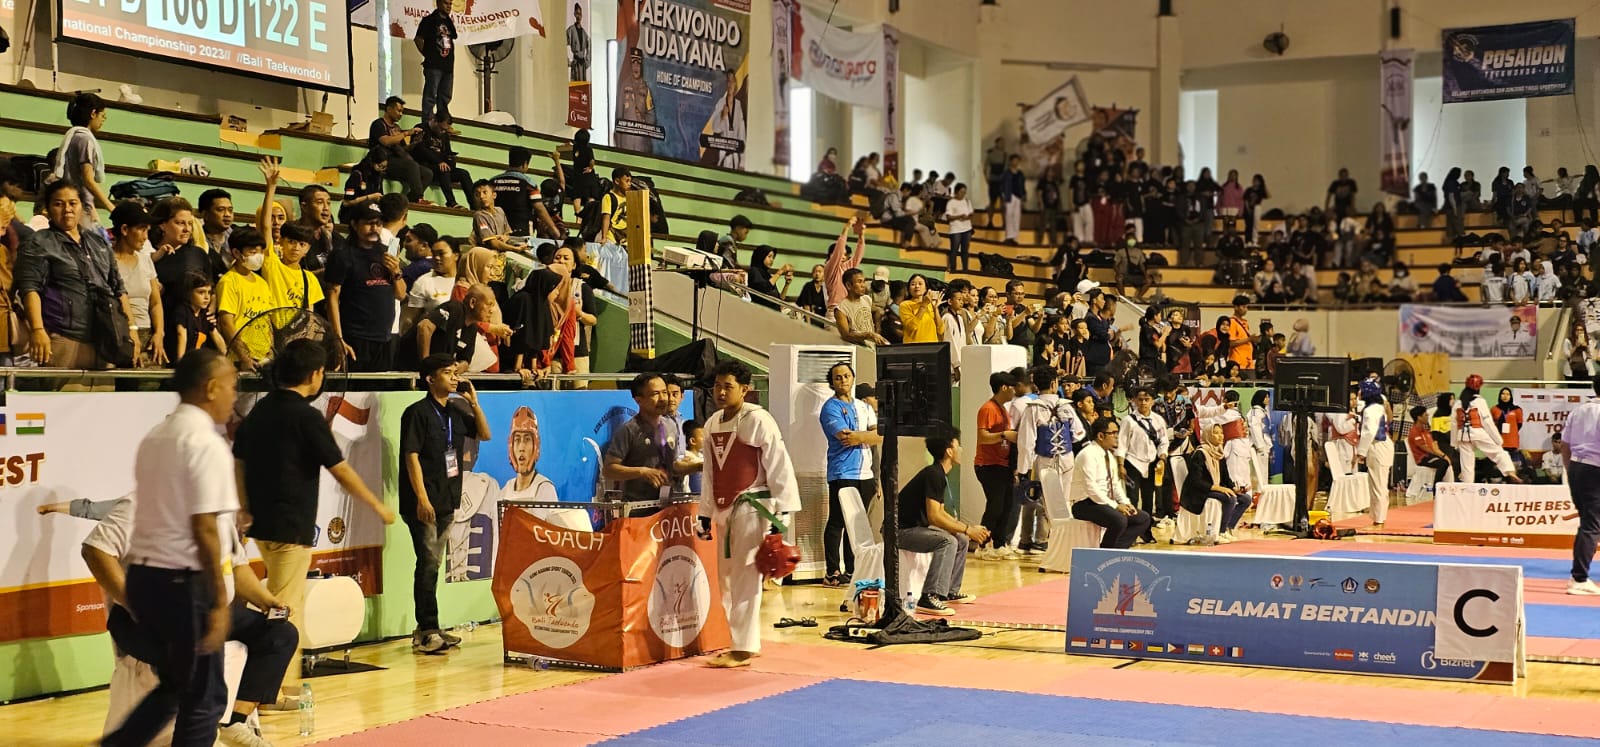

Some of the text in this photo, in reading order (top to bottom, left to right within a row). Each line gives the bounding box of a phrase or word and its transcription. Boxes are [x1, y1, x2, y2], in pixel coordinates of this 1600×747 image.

[249, 0, 328, 53] 122 E
[456, 9, 520, 24] TAEKWONDO
[634, 0, 740, 46] TAEKWONDO
[64, 18, 112, 36] national
[115, 26, 197, 55] Championship
[265, 58, 322, 80] Taekwondo
[644, 27, 726, 71] UDAYANA
[1482, 45, 1566, 70] POSAIDON
[656, 70, 672, 85] HOME
[681, 76, 713, 94] CHAMPIONS
[1527, 411, 1569, 422] ALL TH
[1486, 501, 1571, 513] ALL THE BES
[1506, 514, 1559, 526] TODAY
[533, 525, 604, 551] COACH
[650, 514, 699, 543] COACH
[1187, 598, 1437, 627] SELAMAT BERTANDIN
[1454, 589, 1500, 637] C
